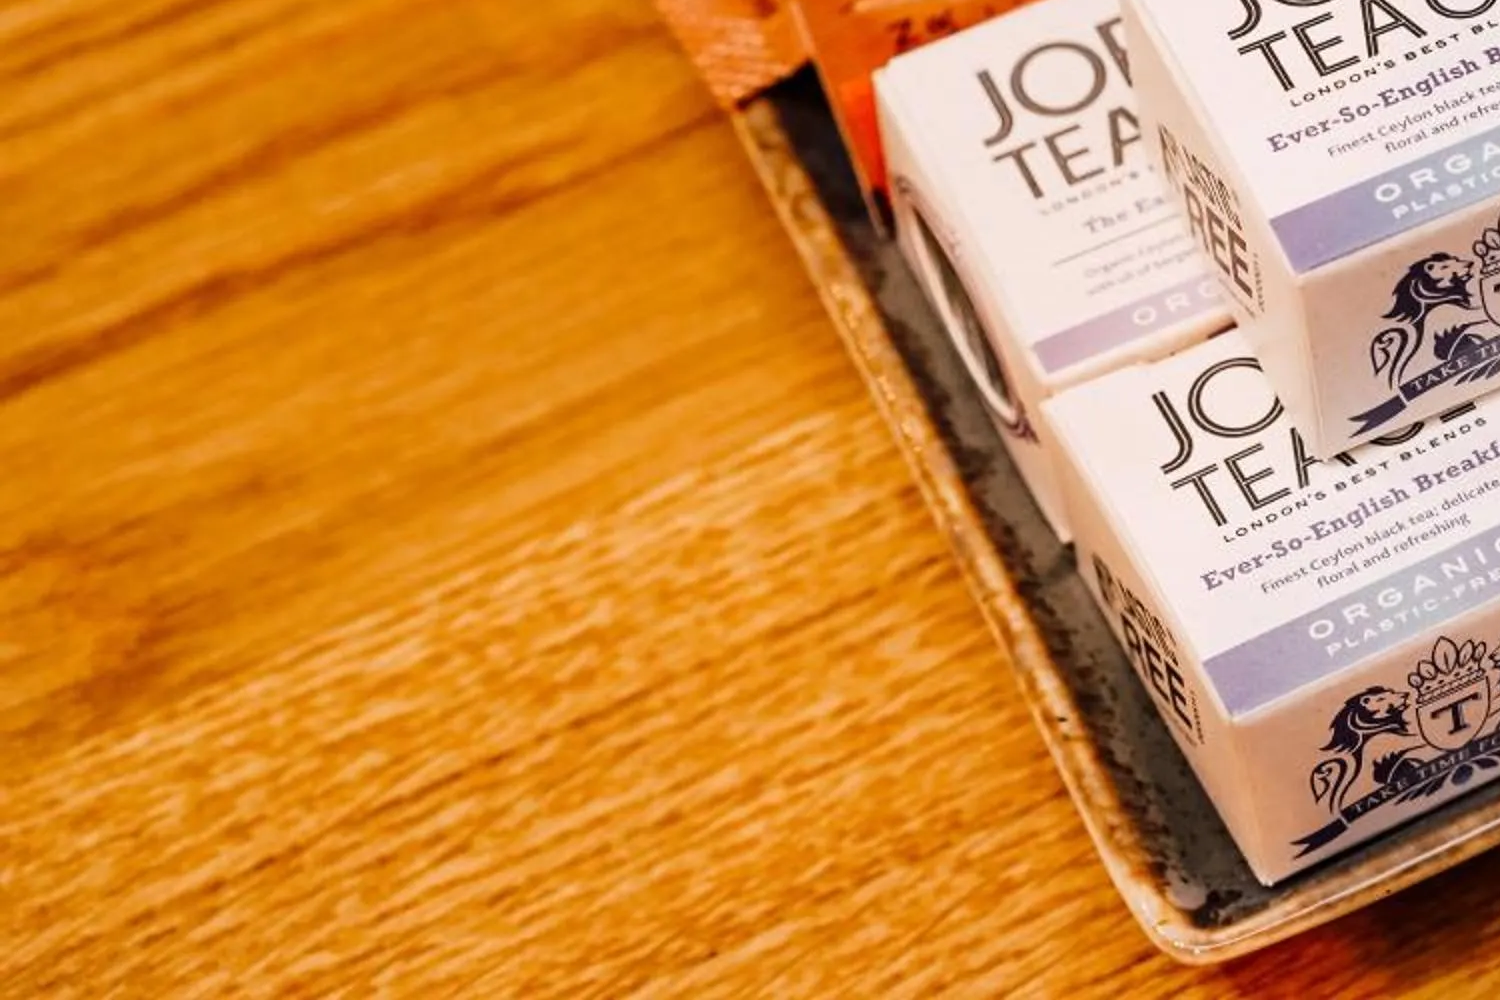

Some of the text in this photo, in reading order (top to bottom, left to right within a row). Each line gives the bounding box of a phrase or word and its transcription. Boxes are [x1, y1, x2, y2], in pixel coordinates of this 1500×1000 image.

[1267, 58, 1481, 153] Ever-So-English
[1289, 58, 1397, 108] LONDON'S
[1405, 31, 1460, 62] BEST
[1327, 131, 1376, 158] Finest
[1377, 107, 1434, 142] Ceylon
[1434, 90, 1475, 116] black
[1384, 127, 1428, 154] floral
[1430, 115, 1460, 137] and
[1411, 357, 1469, 393] TAKE
[1222, 491, 1328, 543] LONDON'S
[1334, 459, 1390, 492] BEST
[1399, 416, 1488, 462] BLENDS
[1201, 488, 1411, 592] Ever-So-English
[1260, 566, 1307, 595] Finest
[1309, 539, 1364, 577] Ceylon
[1363, 520, 1406, 549] black
[1316, 512, 1472, 590] floral and refreshing
[1430, 692, 1481, 735] T
[1353, 777, 1410, 815] TAKE
[1415, 746, 1471, 780] TIME
